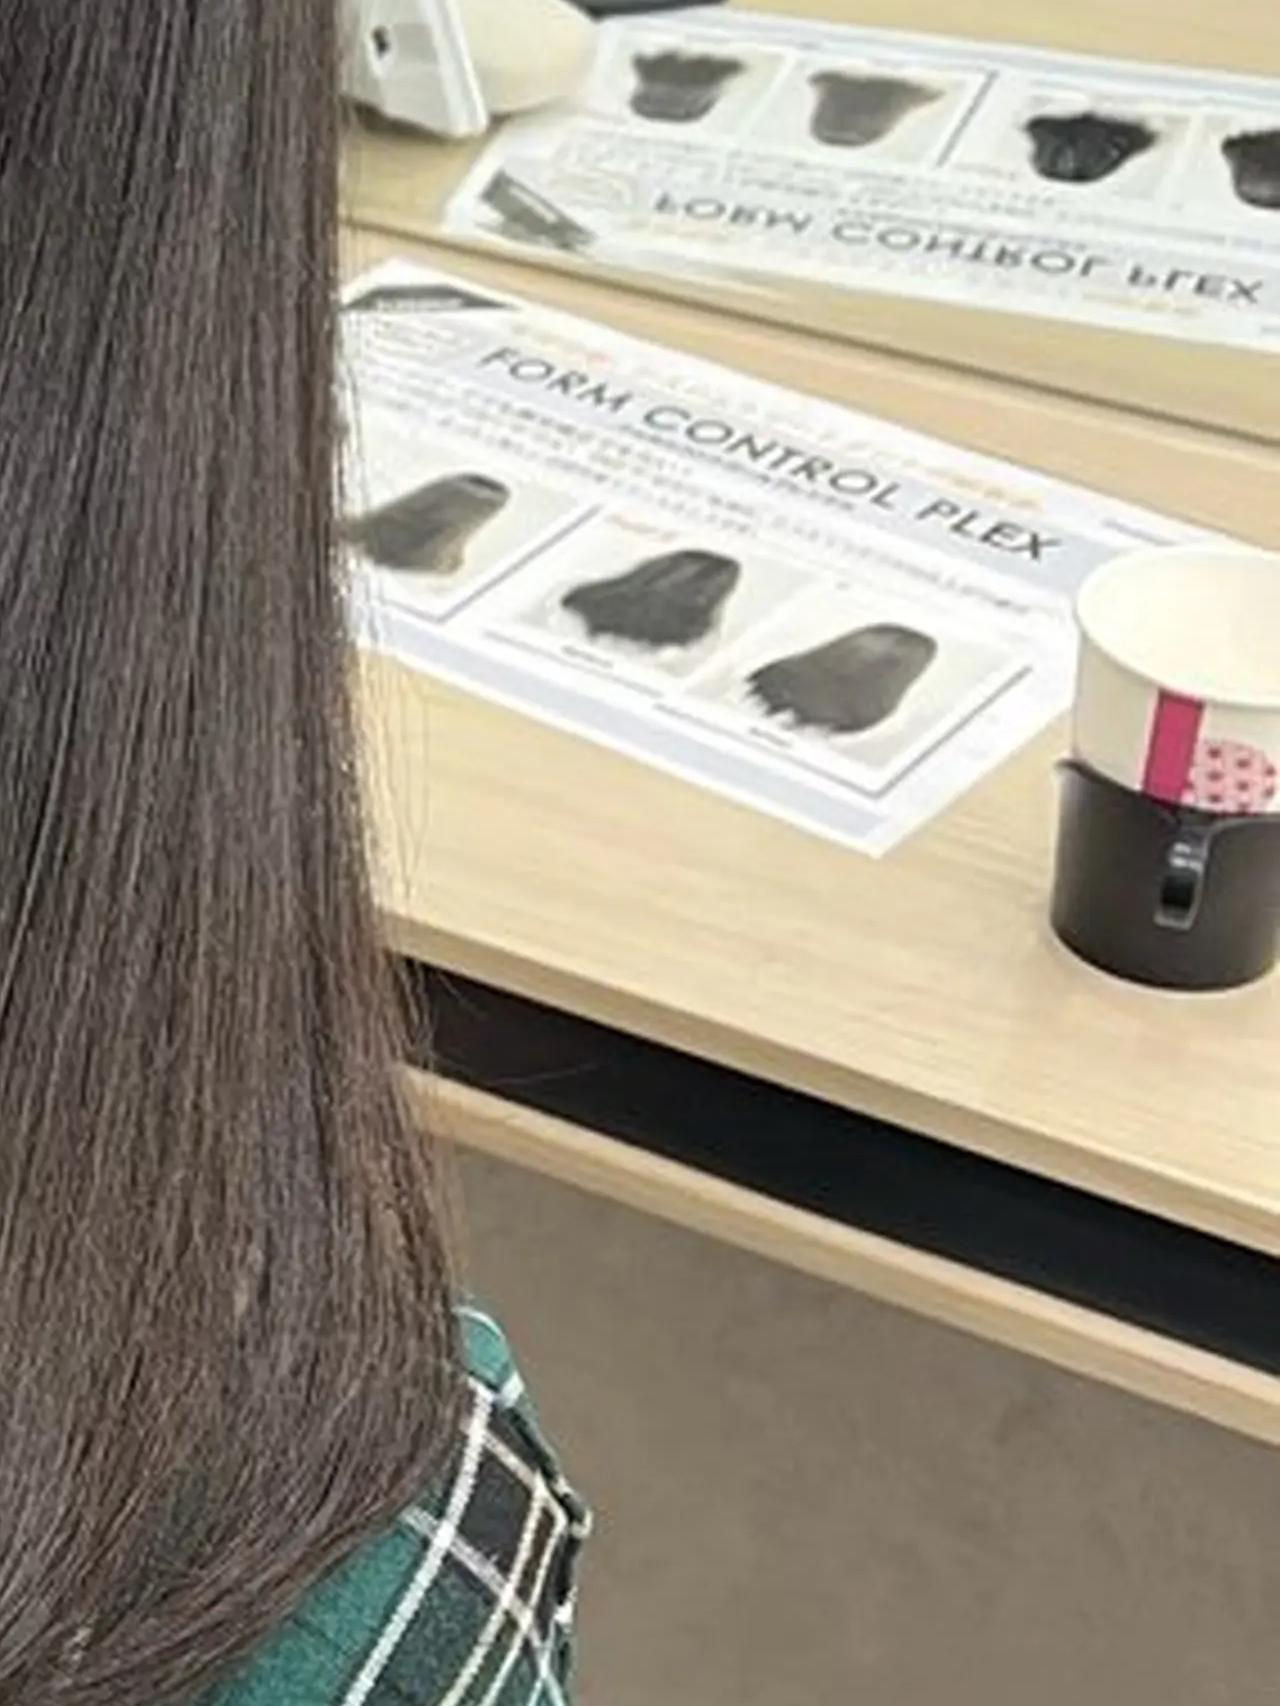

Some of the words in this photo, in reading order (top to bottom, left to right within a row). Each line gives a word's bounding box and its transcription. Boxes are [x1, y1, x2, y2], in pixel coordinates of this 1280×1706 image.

[475, 346, 635, 413] FORM
[642, 404, 901, 511] CONTROL
[913, 497, 1064, 561] PLEX
